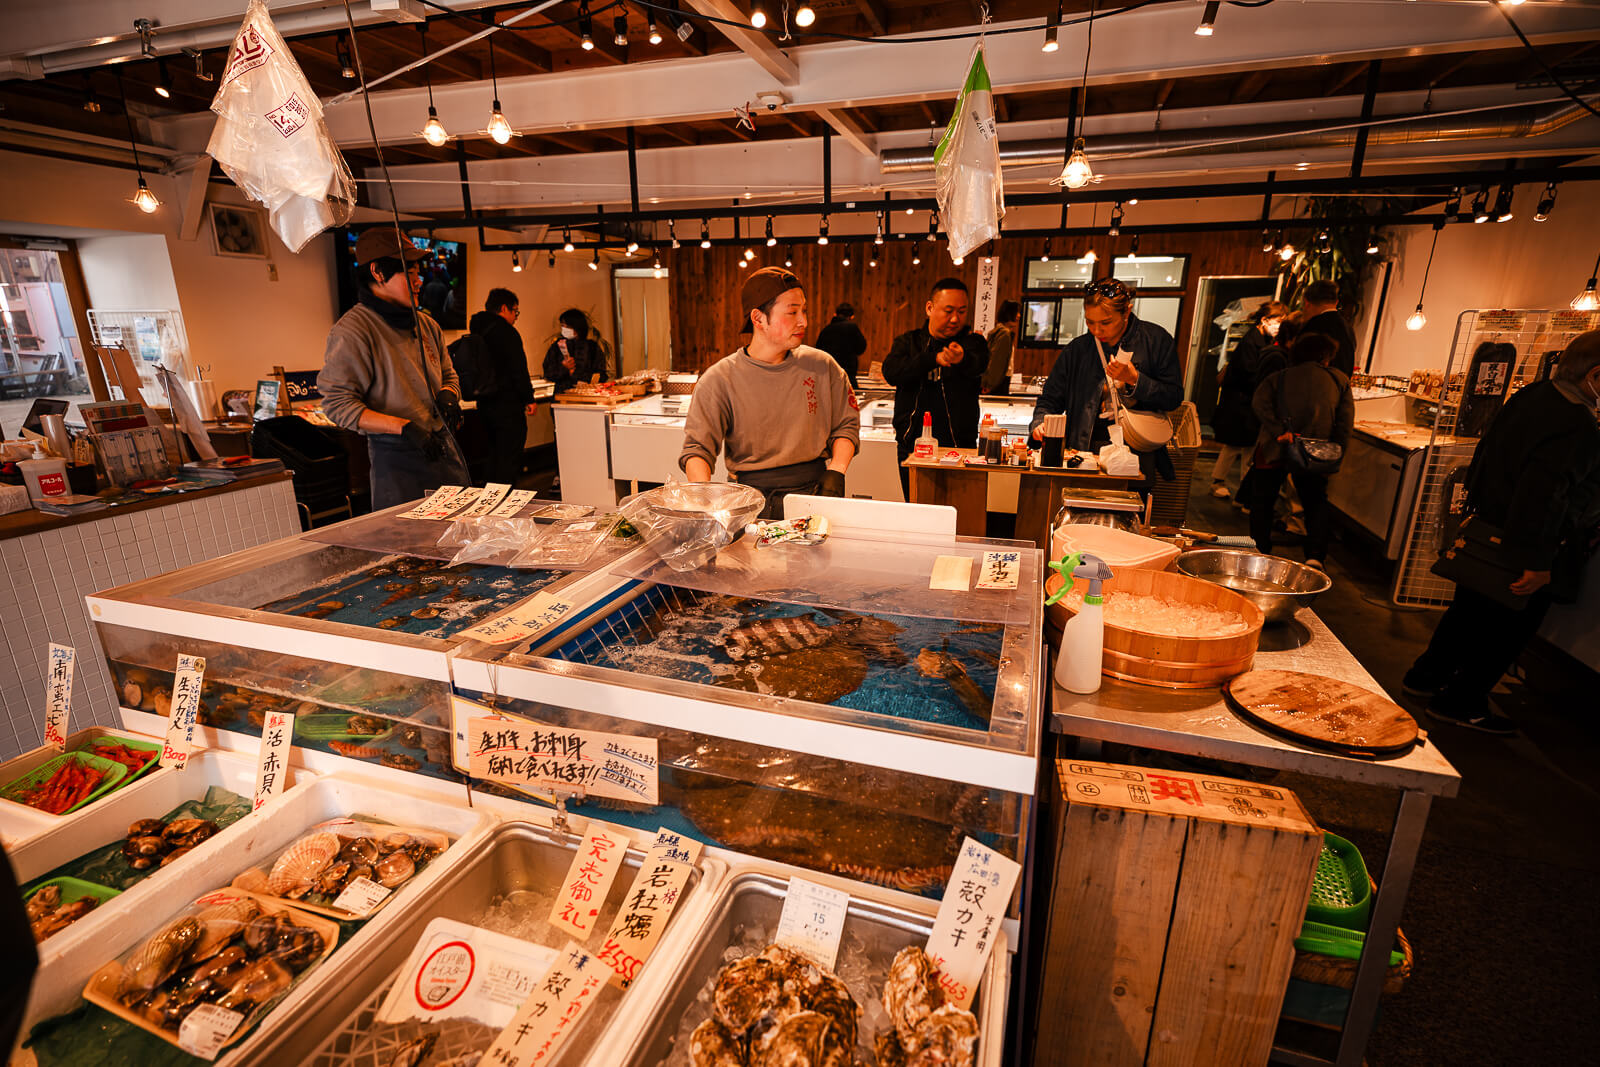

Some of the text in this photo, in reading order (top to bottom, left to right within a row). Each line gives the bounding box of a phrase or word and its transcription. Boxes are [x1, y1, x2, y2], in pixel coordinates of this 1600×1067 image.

[170, 676, 190, 730] 生ワカメ
[558, 833, 616, 931] 完売御礼
[812, 911, 826, 925] 15
[951, 879, 988, 948] 殻カキ
[975, 914, 997, 955] 生食用
[516, 971, 572, 1046] 殻カキ
